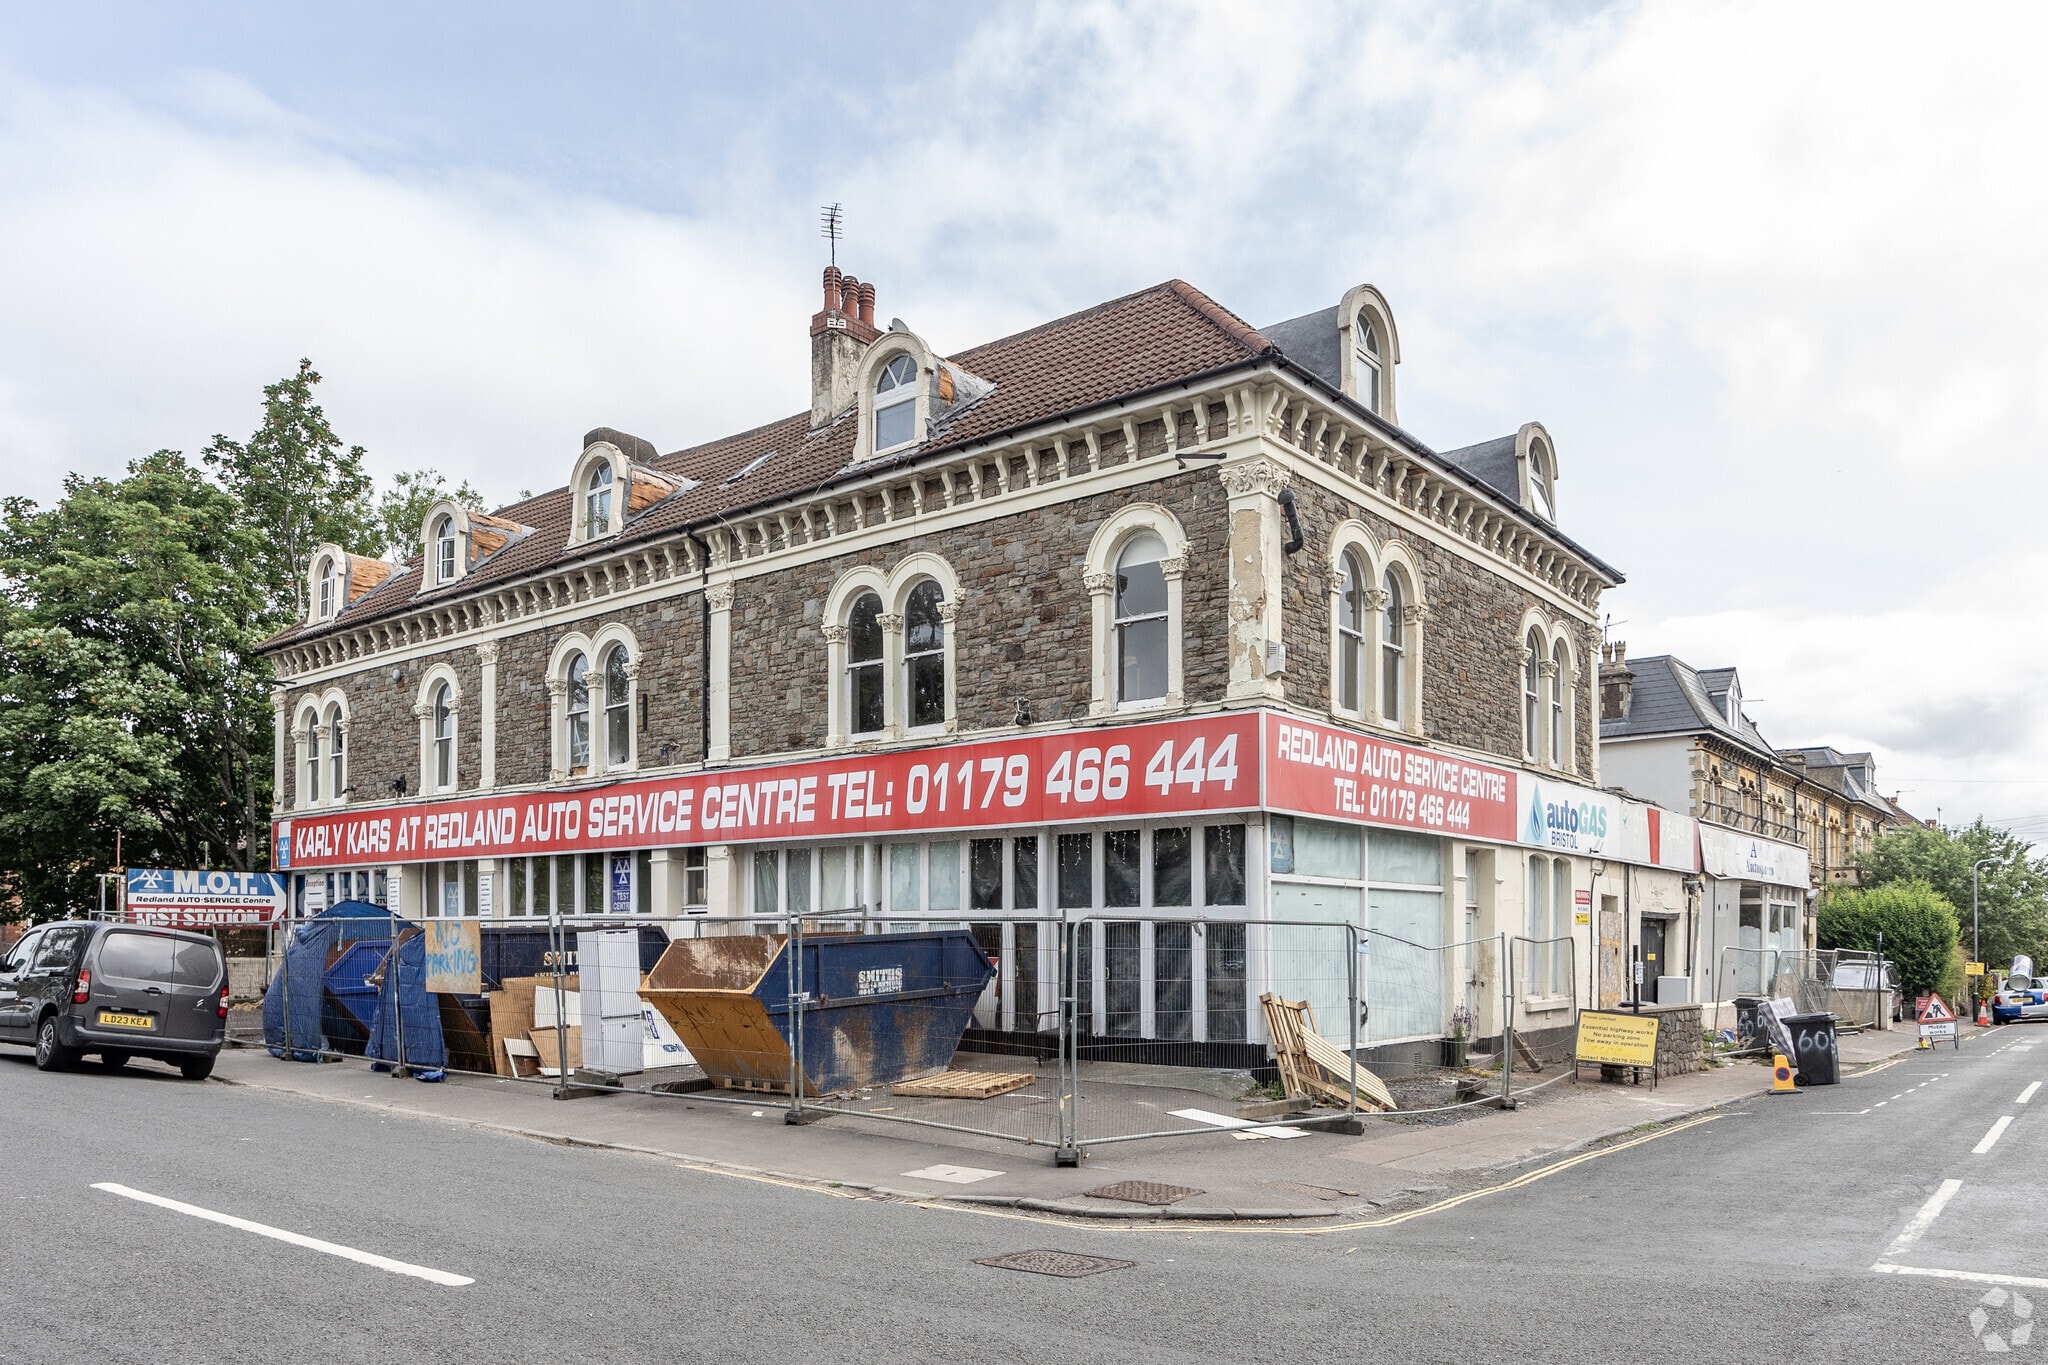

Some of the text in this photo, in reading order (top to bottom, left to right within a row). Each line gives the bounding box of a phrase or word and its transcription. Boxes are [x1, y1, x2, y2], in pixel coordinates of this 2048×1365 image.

[1278, 724, 1506, 802] REDLAND AUTO SERVICE CENTRE
[295, 733, 1239, 859] KARLY KARS AT REDLAND AUTO SERVICE CENTRE TEL: 01179 466 444
[1333, 777, 1470, 830] TEL: 01179 466 444
[1547, 799, 1607, 839] autoGAS
[1551, 830, 1578, 850] BRISTOL
[173, 870, 258, 895] M.O.T.
[136, 895, 175, 903] Redland
[617, 892, 629, 901] TEST
[133, 907, 260, 927] TEST STATION
[435, 920, 461, 949] NO
[425, 948, 479, 979] PARKING
[858, 967, 903, 983] SMITHS
[104, 1014, 148, 1026] LD23 KEA
[1609, 1027, 1634, 1035] highway
[1798, 1028, 1829, 1051] 60
